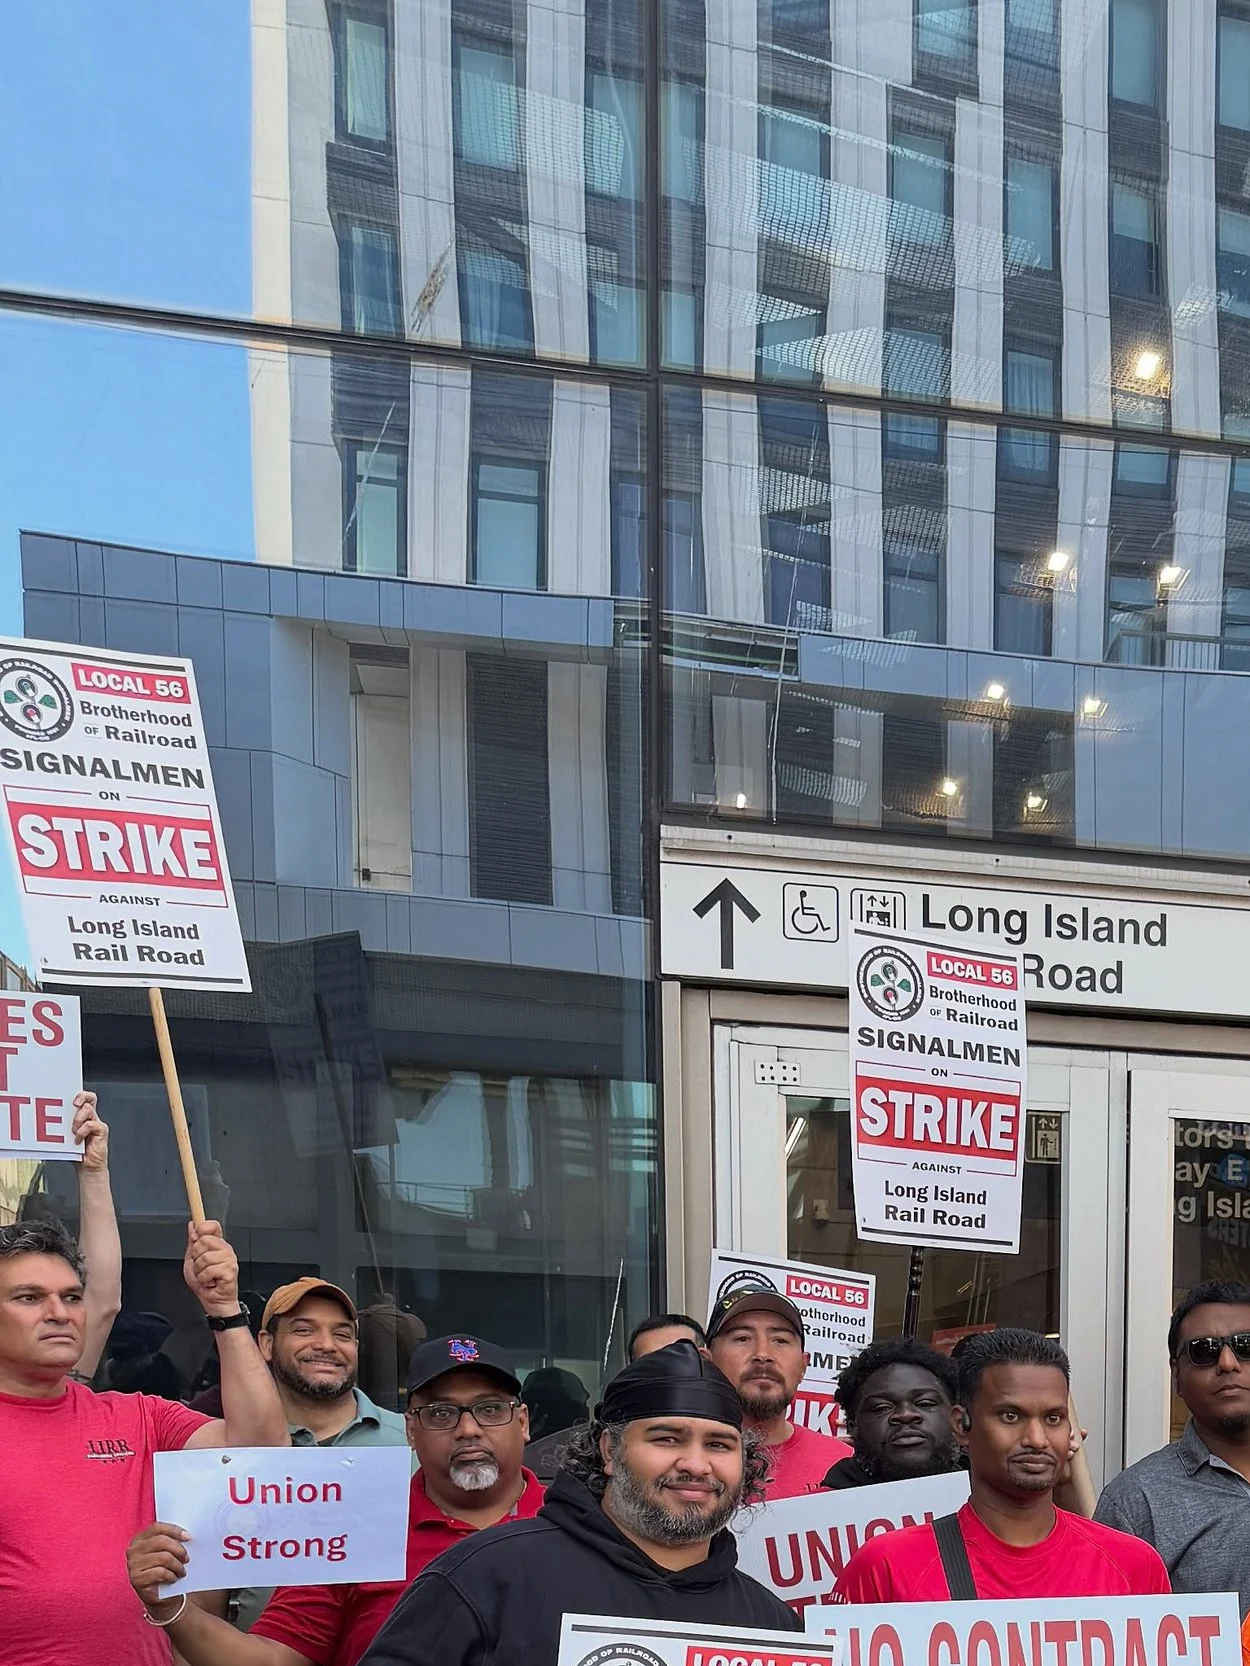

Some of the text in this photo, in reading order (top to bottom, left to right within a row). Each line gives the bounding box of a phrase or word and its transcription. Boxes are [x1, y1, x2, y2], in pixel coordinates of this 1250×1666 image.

[78, 668, 184, 698] LOCAL 56
[80, 701, 192, 727] Brotherhood
[84, 726, 197, 750] OF Railroad
[1, 748, 205, 789] SIGNALMEN
[99, 791, 121, 801] ON
[17, 813, 218, 881] STRIKE
[99, 894, 161, 907] AGAINST
[67, 915, 199, 941] Long Island
[922, 894, 1167, 947] Long Island
[72, 942, 205, 966] Rail Road
[931, 957, 1013, 985] LOCAL 56
[1023, 953, 1123, 995] Road
[929, 985, 1016, 1011] Brotherhood
[946, 1009, 1018, 1031] Railroad
[857, 1027, 1020, 1067] SIGNALMEN
[931, 1068, 948, 1077] ON
[860, 1087, 1016, 1151] STRIKE
[912, 1162, 962, 1174] AGAINST
[1227, 1160, 1243, 1181] E
[885, 1180, 987, 1205] Long Island
[885, 1205, 986, 1229] Rail Road
[790, 1279, 841, 1301] LOCAL
[844, 1290, 865, 1305] 56
[800, 1307, 866, 1327] otherhood
[228, 1476, 343, 1505] Union
[222, 1533, 348, 1561] Strong
[616, 1647, 660, 1666] RAILROAD
